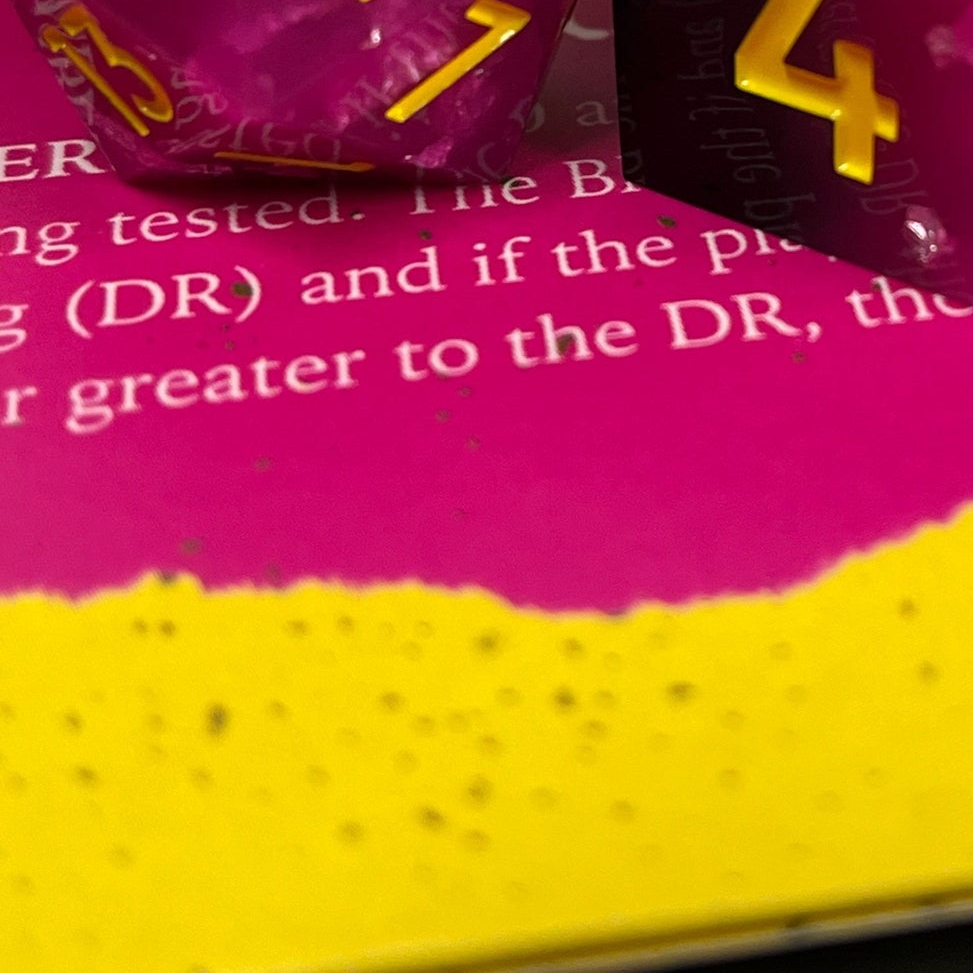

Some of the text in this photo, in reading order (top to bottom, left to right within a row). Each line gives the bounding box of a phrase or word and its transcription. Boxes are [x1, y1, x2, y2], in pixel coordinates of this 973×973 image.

[108, 173, 366, 246] tested.
[66, 265, 262, 340] (DR)
[300, 246, 447, 305] and
[473, 235, 533, 287] if
[551, 228, 678, 278] the
[65, 349, 367, 435] greater
[395, 338, 479, 381] to
[506, 313, 640, 369] the
[660, 291, 823, 350] DR,
